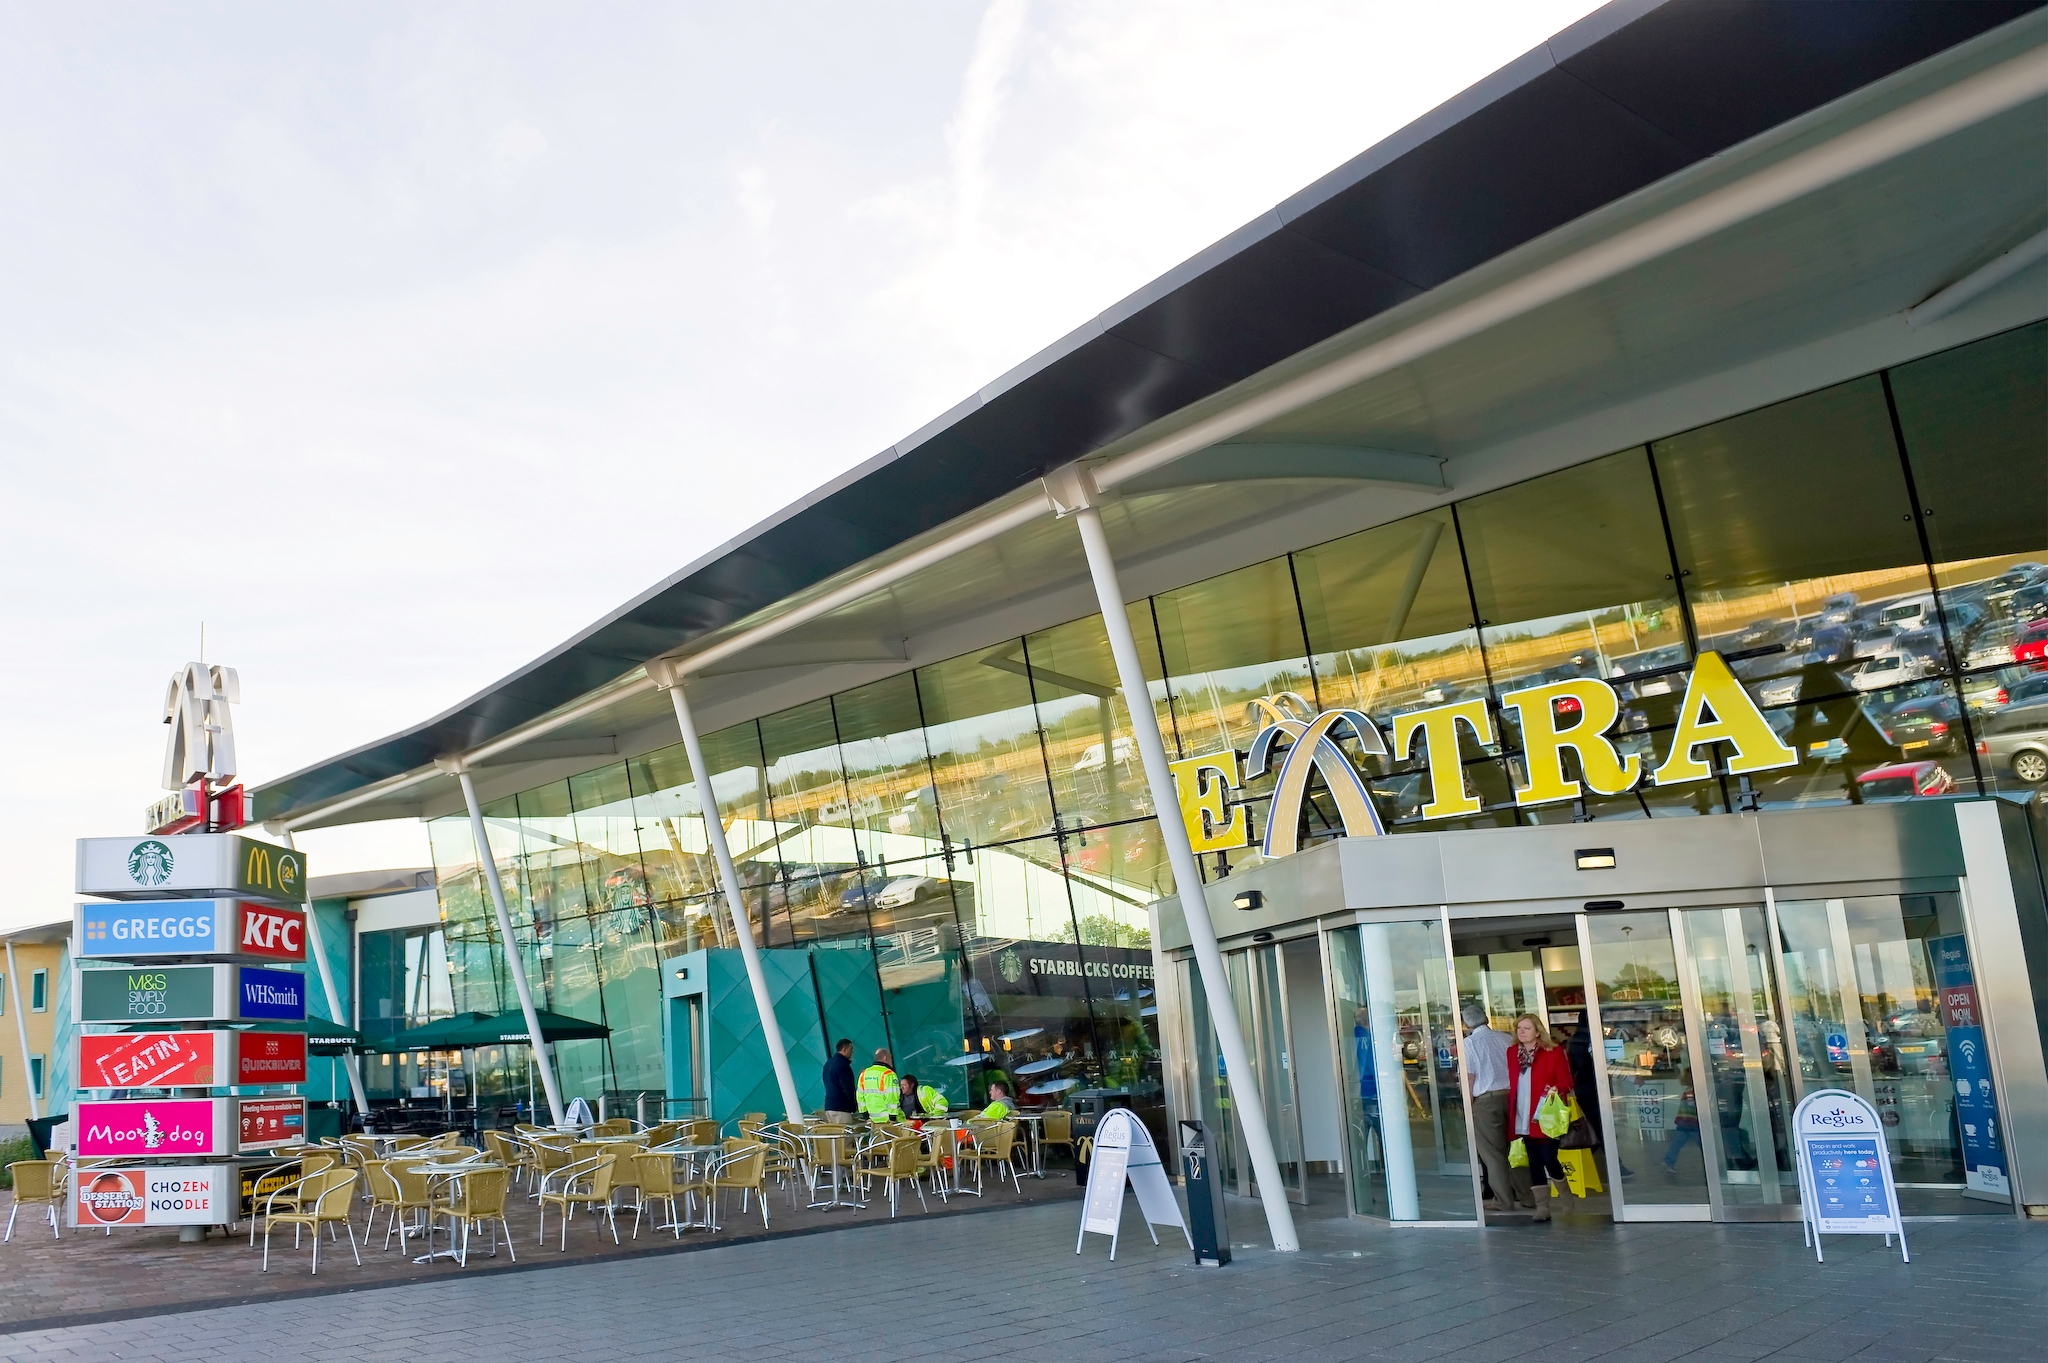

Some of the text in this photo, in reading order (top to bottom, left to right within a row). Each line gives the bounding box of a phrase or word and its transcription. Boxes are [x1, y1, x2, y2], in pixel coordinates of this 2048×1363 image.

[112, 916, 211, 940] GREGGS
[242, 911, 300, 951] KFC
[1030, 958, 1155, 979] STARBUCKS COFFEE
[128, 974, 167, 991] M&S
[128, 991, 167, 1003] SIMPLY
[245, 984, 298, 1005] WHSmith
[1947, 993, 1970, 1006] OPEN
[128, 1003, 167, 1015] FOOD
[1951, 1009, 1971, 1021] NOW
[242, 1058, 301, 1073] QUICKSILVER
[1636, 1088, 1658, 1097] CHO
[1639, 1106, 1660, 1115] NOO
[1641, 1116, 1661, 1124] DLE
[1811, 1113, 1864, 1128] Regus
[87, 1125, 137, 1144] Moo
[169, 1125, 204, 1146] dog
[1103, 1129, 1126, 1142] Regus
[151, 1181, 209, 1193] CHOZEN
[82, 1191, 131, 1201] DESSERT
[94, 1199, 143, 1209] STATION
[151, 1199, 209, 1211] NOODLE
